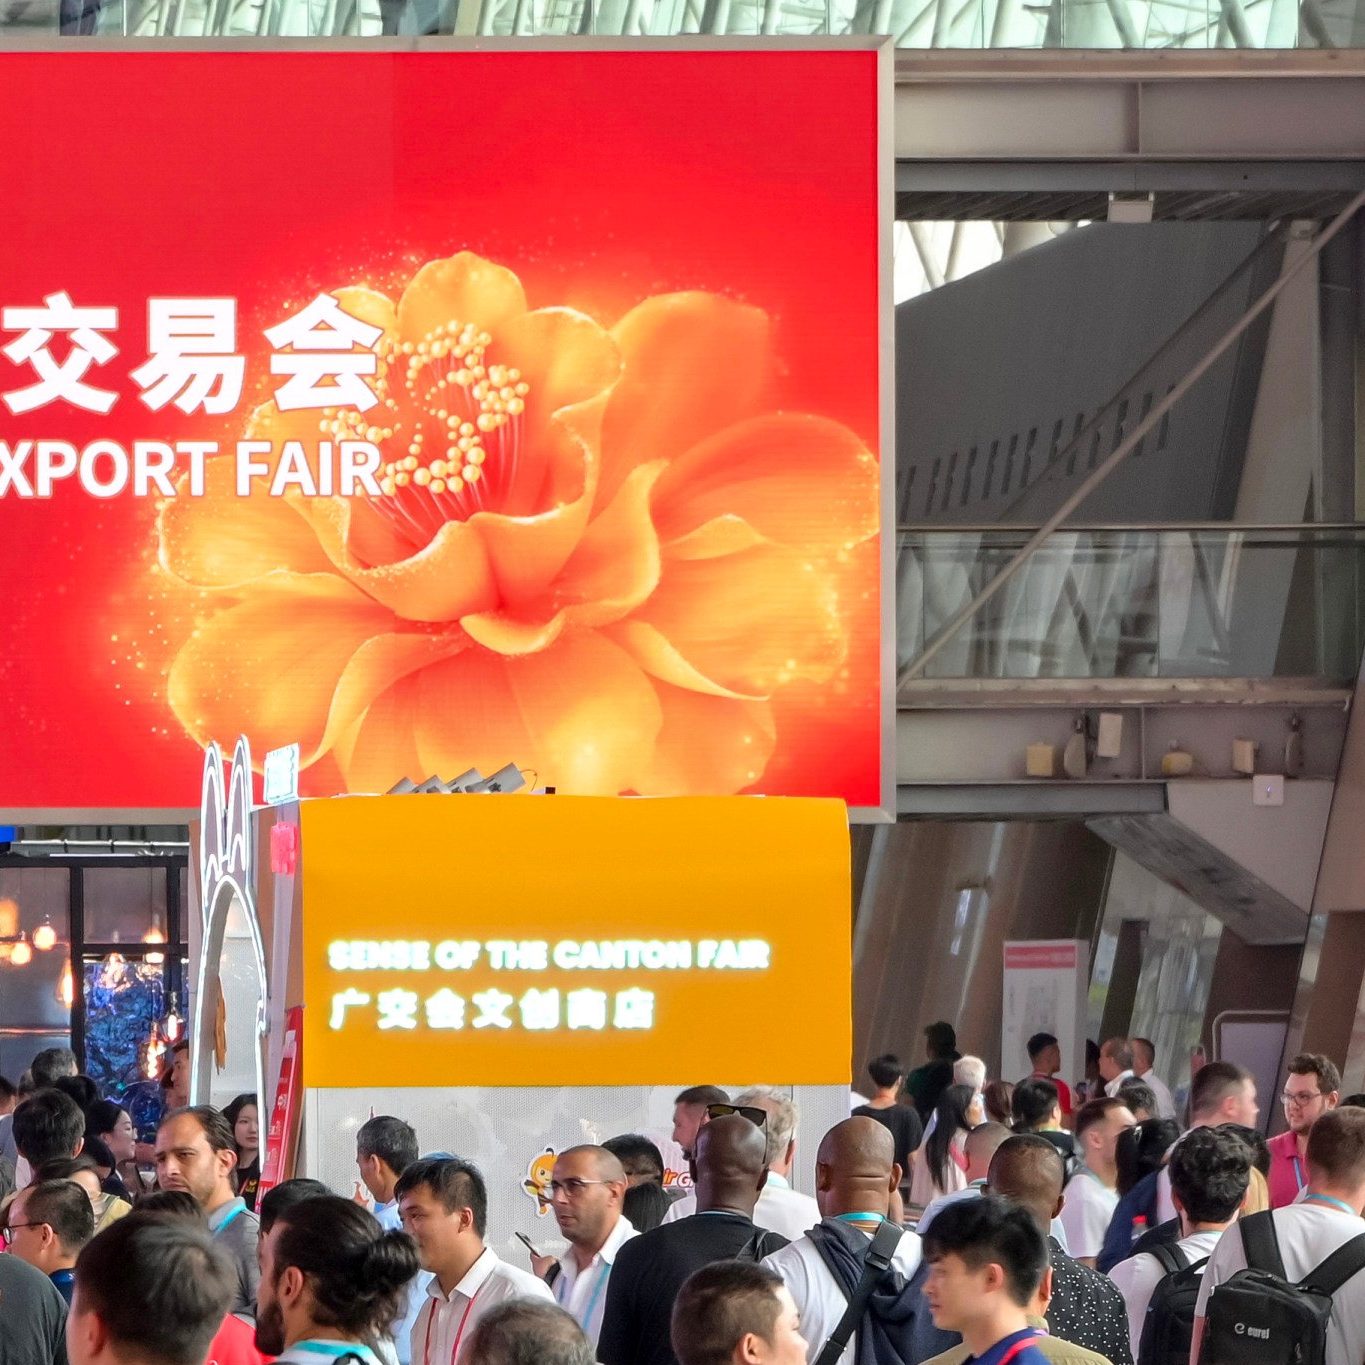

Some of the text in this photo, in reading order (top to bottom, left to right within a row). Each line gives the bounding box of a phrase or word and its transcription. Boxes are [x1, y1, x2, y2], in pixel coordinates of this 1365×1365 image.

[234, 441, 384, 499] FAIR
[328, 941, 770, 971] SENSE OF THE CANTON FAIR
[329, 987, 656, 1030] 广交会文创商店
